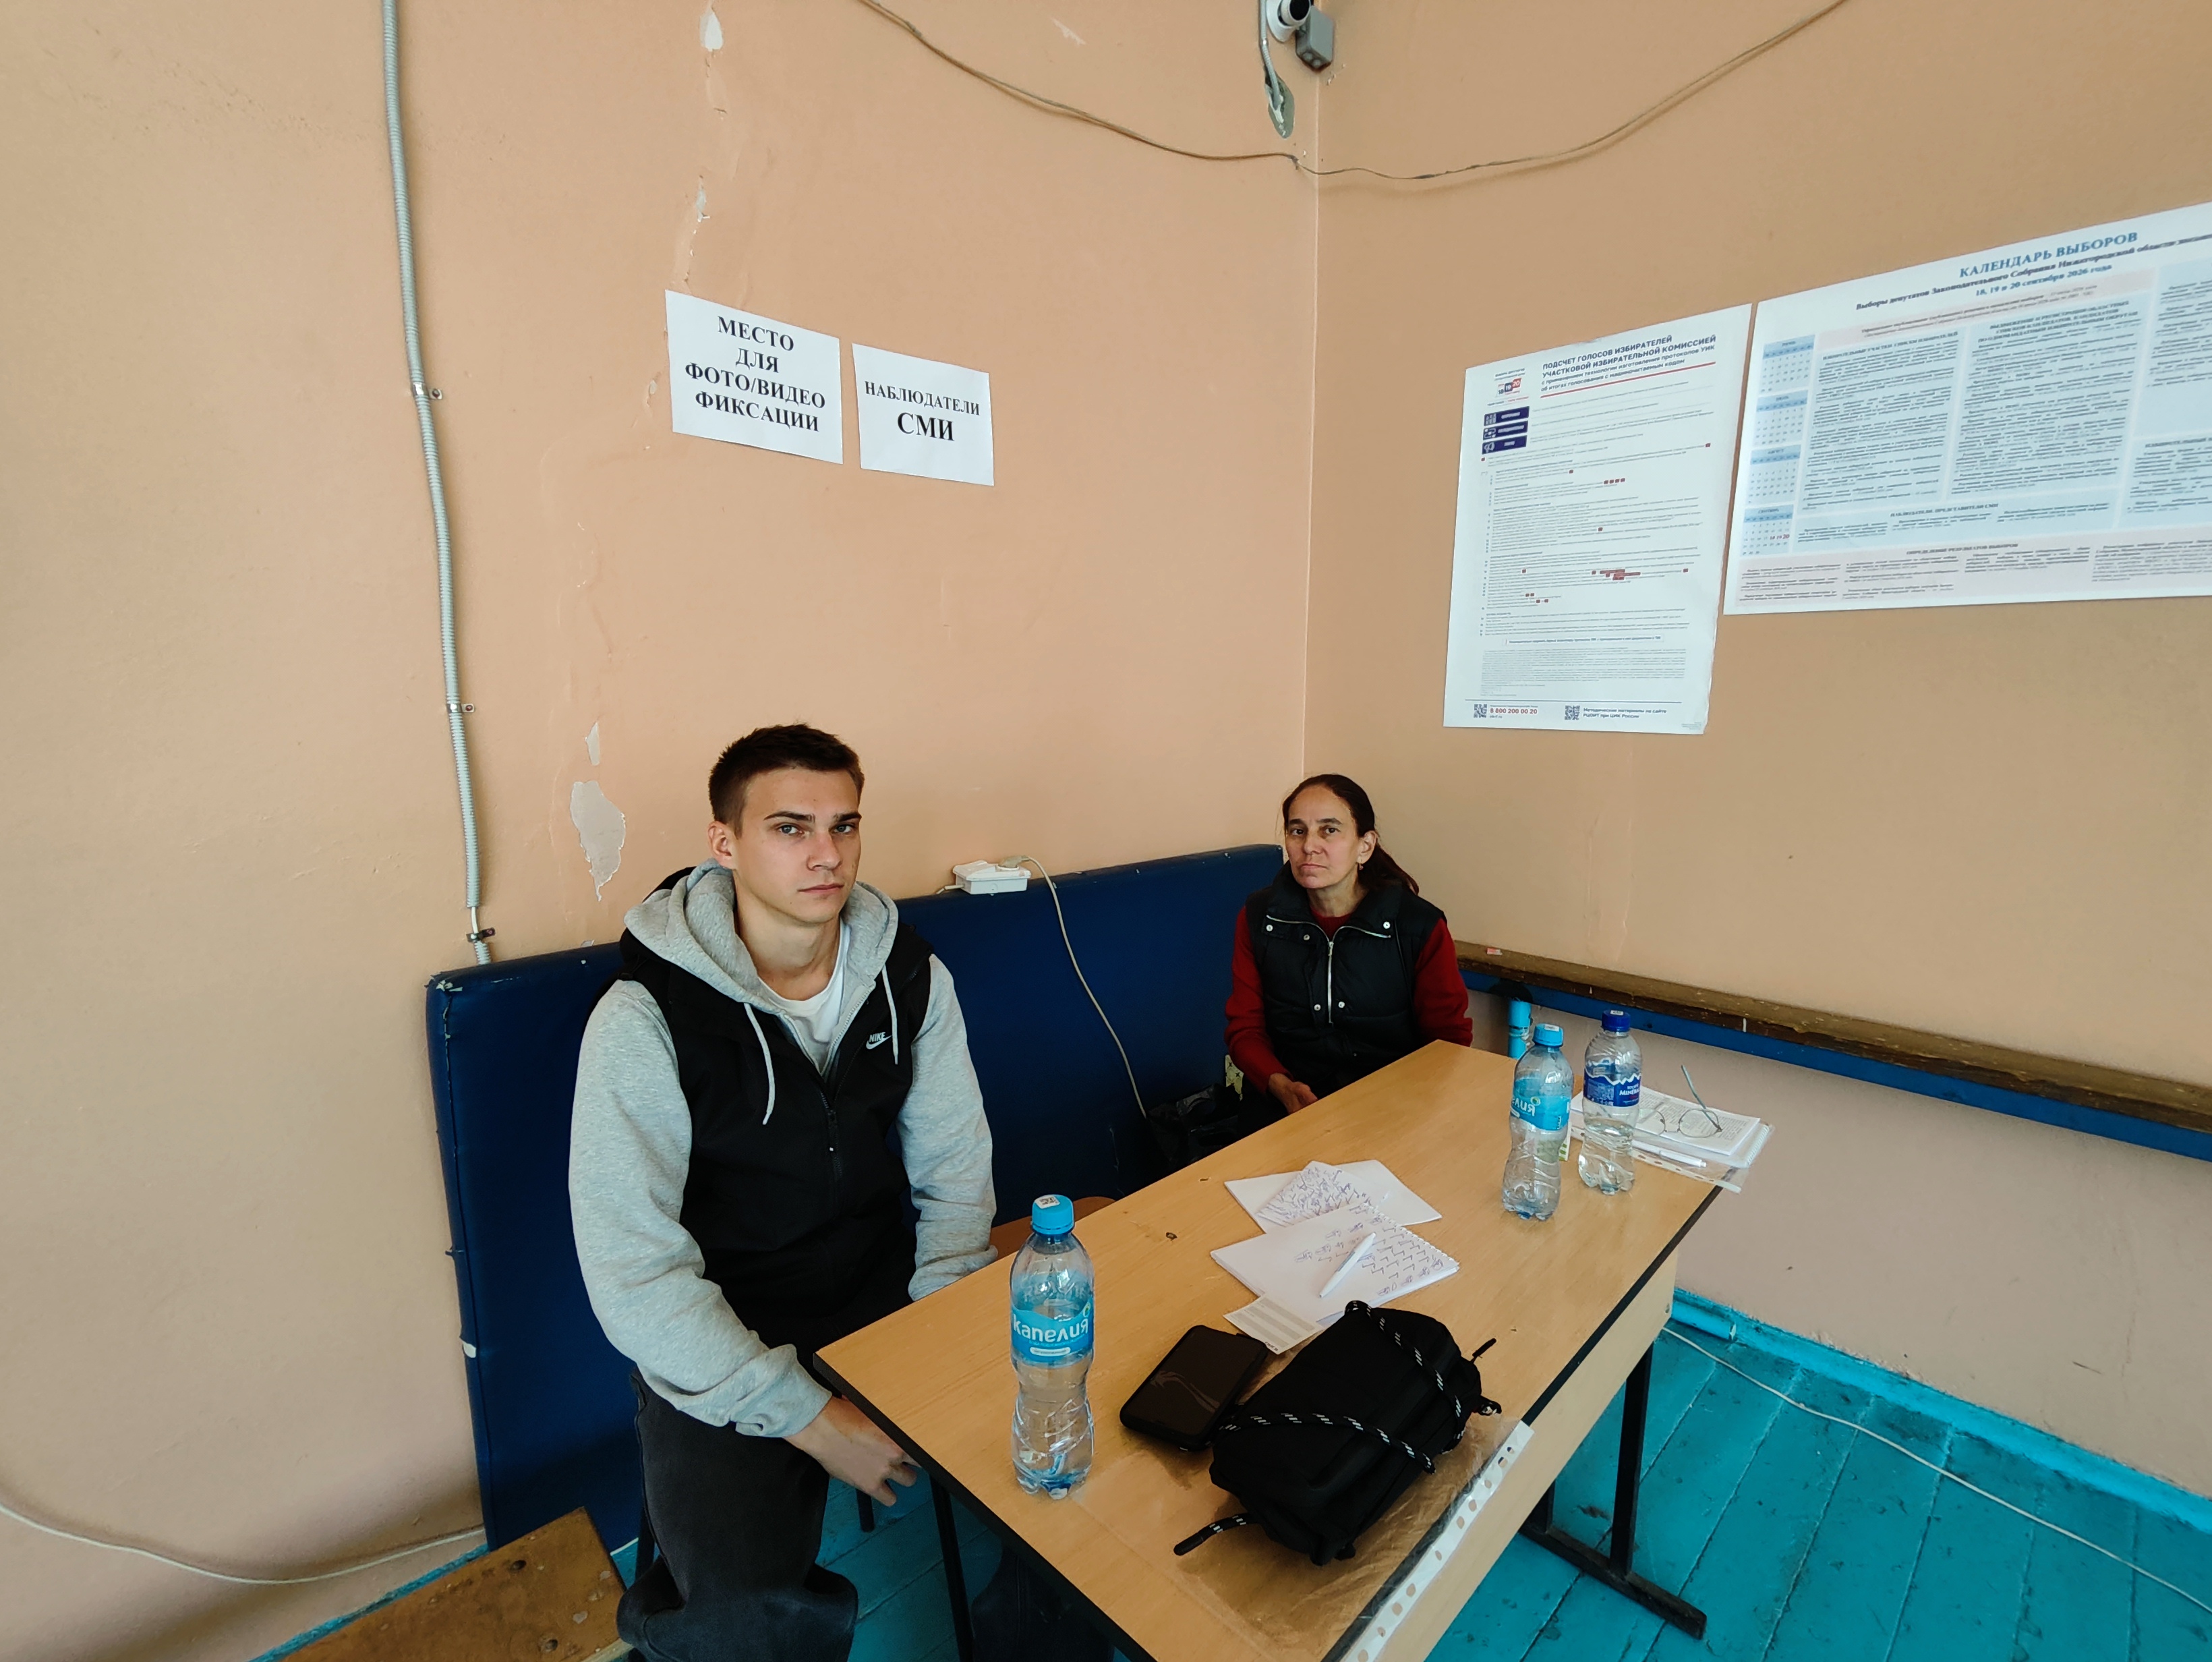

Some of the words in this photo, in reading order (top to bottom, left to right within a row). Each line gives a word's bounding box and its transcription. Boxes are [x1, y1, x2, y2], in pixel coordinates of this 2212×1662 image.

[1959, 250, 2052, 278] КАЛЕНДАРЬ
[2056, 232, 2138, 257] ВЫБОРОВ
[1856, 298, 1888, 310] Выборы
[1889, 289, 1930, 304] депутатов
[1931, 273, 2009, 294] Законодательного
[2010, 263, 2056, 278] Собрания
[2058, 247, 2135, 268] Нижегородской
[2010, 281, 2021, 289] 20
[2022, 273, 2064, 287] сентября
[2066, 268, 2089, 279] 2026
[2090, 264, 2112, 274] года
[718, 315, 794, 352] МЕСТО
[735, 347, 780, 374] ДЛЯ
[1542, 357, 1577, 370] ПОДСЧЕТ
[1577, 349, 1613, 363] ГОЛОСОВ
[1614, 335, 1672, 354] ИЗБИРАТЕЛЕЙ
[1542, 362, 1592, 378] УЧАСТКОВОЙ
[1592, 347, 1660, 368] ИЗБИРАТЕЛЬНОЙ
[1662, 334, 1717, 353] КОМИССИЕЙ
[1546, 372, 1583, 384] применением
[1584, 366, 1618, 376] технологии
[1619, 356, 1660, 369] изготовления
[1661, 349, 1699, 361] протоколов
[1701, 345, 1715, 353] УИК
[685, 362, 826, 409] ФОТО/ВИДЕО
[1567, 374, 1604, 387] голосования
[1609, 363, 1664, 378] машиночитаемым
[1664, 359, 1685, 367] кодом
[695, 391, 820, 432] ФИКСАЦИИ
[865, 381, 981, 416] НАБЛЮДАТЕЛИ
[897, 412, 955, 442] СМИ
[869, 1031, 886, 1043] NIKE
[1013, 1313, 1088, 1342] капелия
